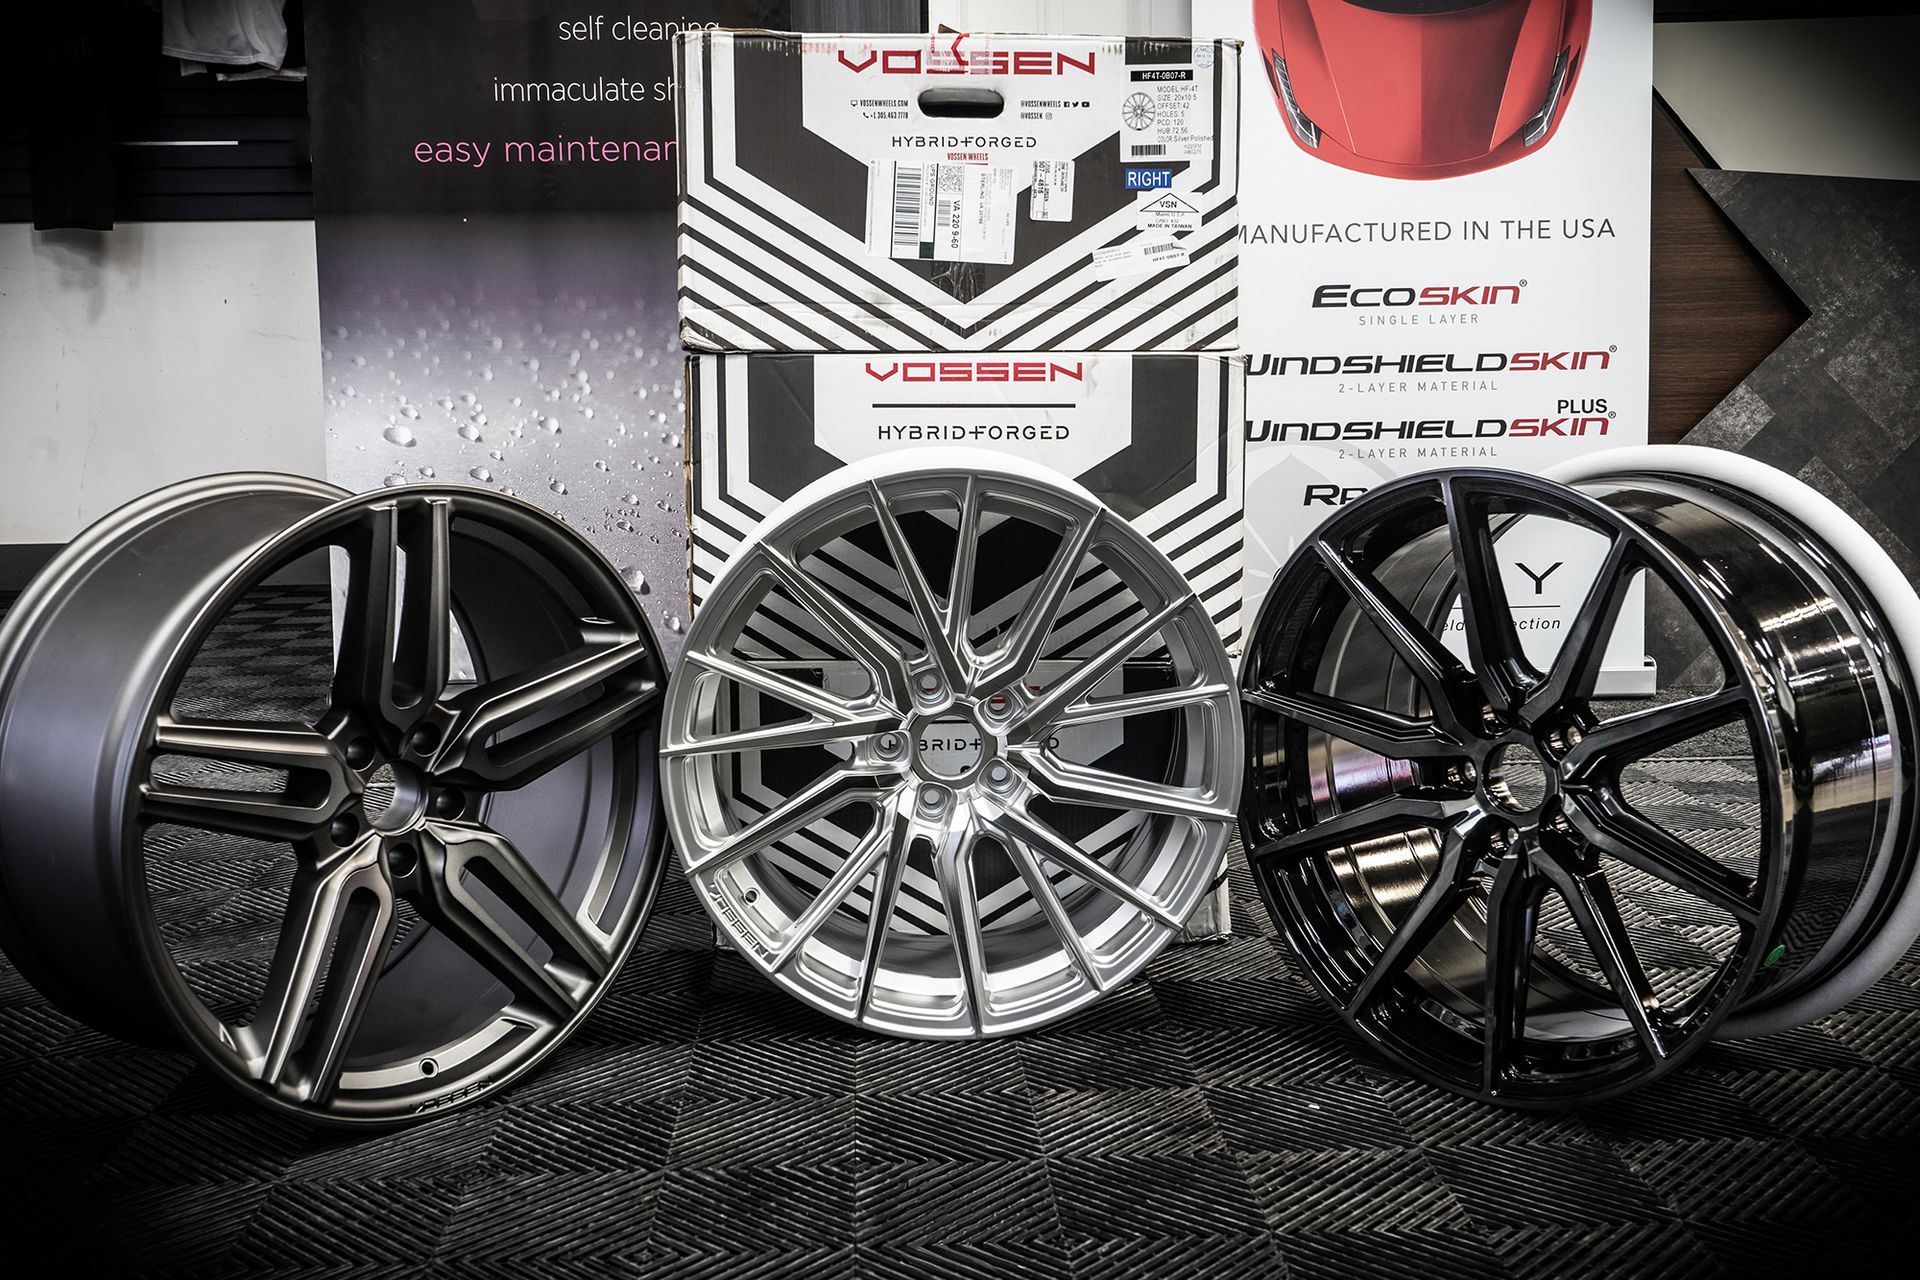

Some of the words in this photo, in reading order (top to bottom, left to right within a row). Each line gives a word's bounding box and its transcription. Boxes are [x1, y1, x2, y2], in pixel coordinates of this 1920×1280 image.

[558, 15, 604, 41] self
[493, 76, 645, 102] immaculate
[891, 136, 1037, 148] HYBRID+FORGED
[414, 142, 491, 168] easy
[947, 153, 967, 161] VOSSEN
[968, 153, 989, 161] WHEELS
[1127, 171, 1170, 187] RIGHT
[953, 200, 961, 211] VA
[1159, 200, 1178, 208] VSN
[952, 214, 960, 229] 220
[1463, 220, 1490, 240] IN
[1500, 219, 1552, 239] THE
[1563, 218, 1616, 239] USA
[1358, 315, 1419, 326] SINGLE
[1429, 313, 1479, 325] LAYER
[865, 362, 1083, 382] VOSSEN
[1338, 381, 1408, 394] 2-LAYER
[1417, 380, 1499, 392] MATERIAL
[1557, 398, 1608, 414] PLUS
[878, 425, 1070, 440] HYBRID+FORGED
[1338, 448, 1408, 460] 2-LAYER
[1417, 447, 1498, 458] MATERIAL
